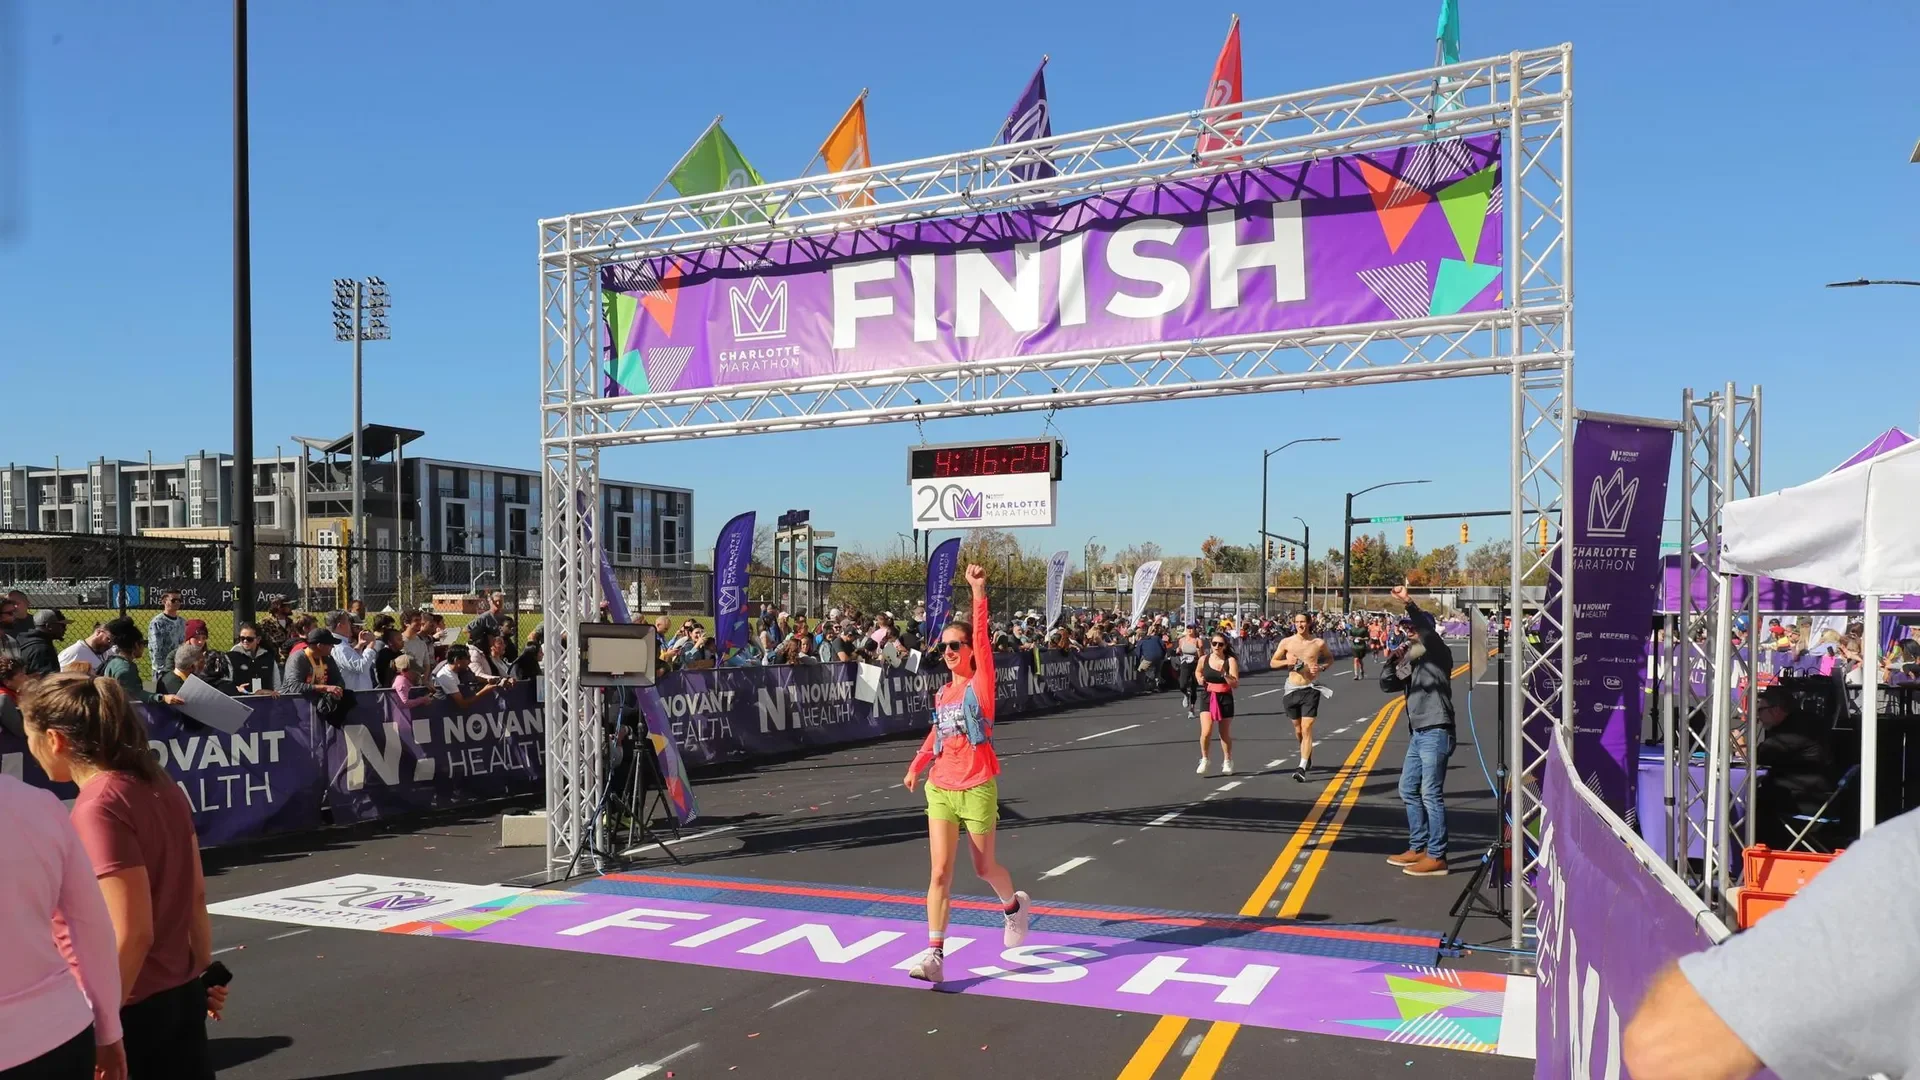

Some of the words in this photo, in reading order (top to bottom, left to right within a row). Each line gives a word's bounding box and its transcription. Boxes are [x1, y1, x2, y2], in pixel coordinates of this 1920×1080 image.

[832, 199, 1307, 349] FINISH
[719, 346, 801, 361] CHARLOTTE
[719, 357, 800, 373] MARATHON
[985, 500, 1047, 509] CHARLOTTE
[985, 508, 1047, 517] MARATHON
[188, 596, 206, 605] Gas
[1585, 610, 1608, 618] HEALTH
[995, 666, 1020, 682] OVANT
[1046, 662, 1071, 677] NOVANT
[904, 673, 949, 692] NOVANT
[995, 683, 1018, 700] ALTH
[802, 681, 854, 704] NOVANT
[906, 694, 936, 713] HEAL
[803, 704, 851, 727] HEALTH
[443, 708, 546, 744] NOVAN
[671, 716, 733, 748] EALTH
[148, 730, 285, 771] OVANT
[253, 902, 388, 920] CHARLOTTE
[555, 907, 1280, 1005] FINISH
